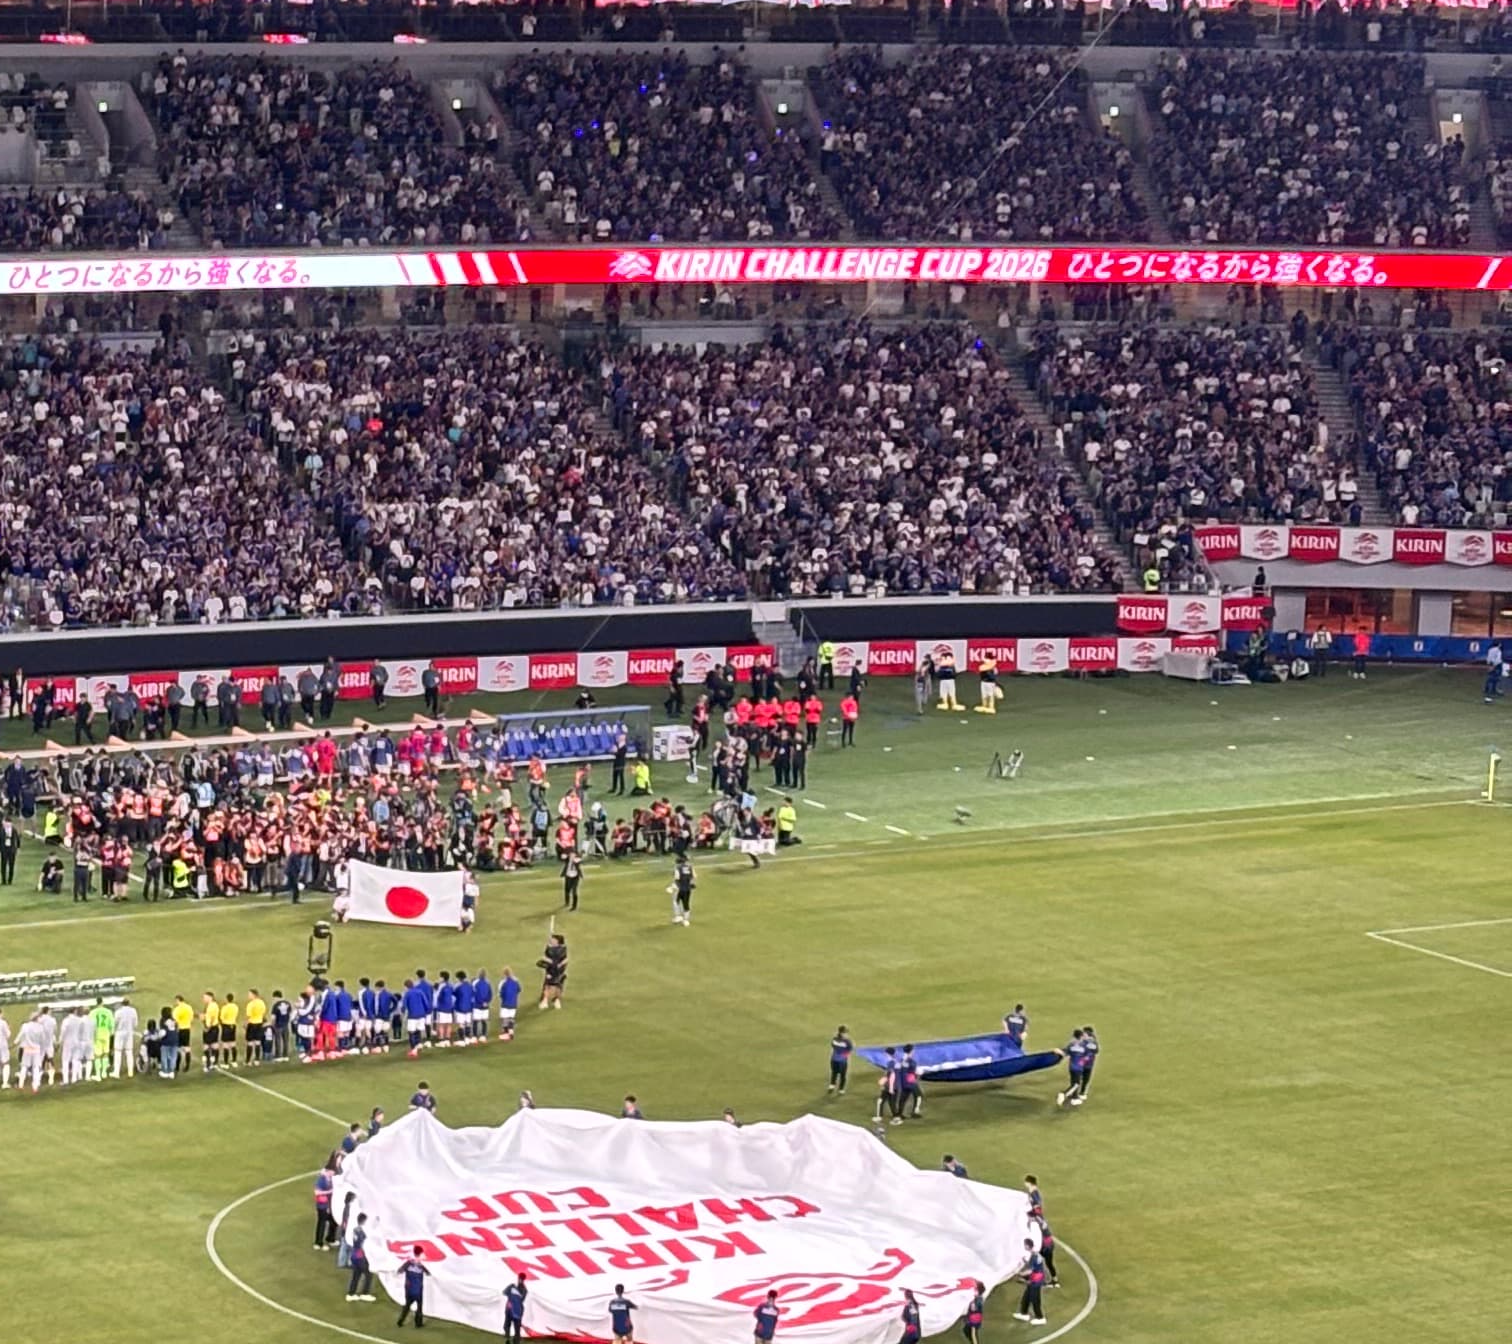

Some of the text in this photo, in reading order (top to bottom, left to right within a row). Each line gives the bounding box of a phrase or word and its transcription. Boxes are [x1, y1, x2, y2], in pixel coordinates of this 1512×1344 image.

[8, 258, 311, 289] ひとつになるから強くなる。
[654, 250, 1051, 280] KIRIN CHALLENGE CUP 2026
[1067, 253, 1388, 284] ひとつになるから強くなる。
[1291, 534, 1338, 551] KIRIN
[1396, 538, 1443, 554] KIRIN
[1118, 605, 1165, 621] KIRIN
[869, 648, 914, 665] KIRIN
[1070, 645, 1116, 662] KIRIN
[439, 666, 476, 684] IRIN
[531, 662, 576, 680] KIRIN
[629, 658, 675, 674] KIRIN
[441, 1186, 611, 1223] CUP
[386, 1195, 822, 1262] CHALLENG
[502, 1231, 766, 1281] KIRIN
